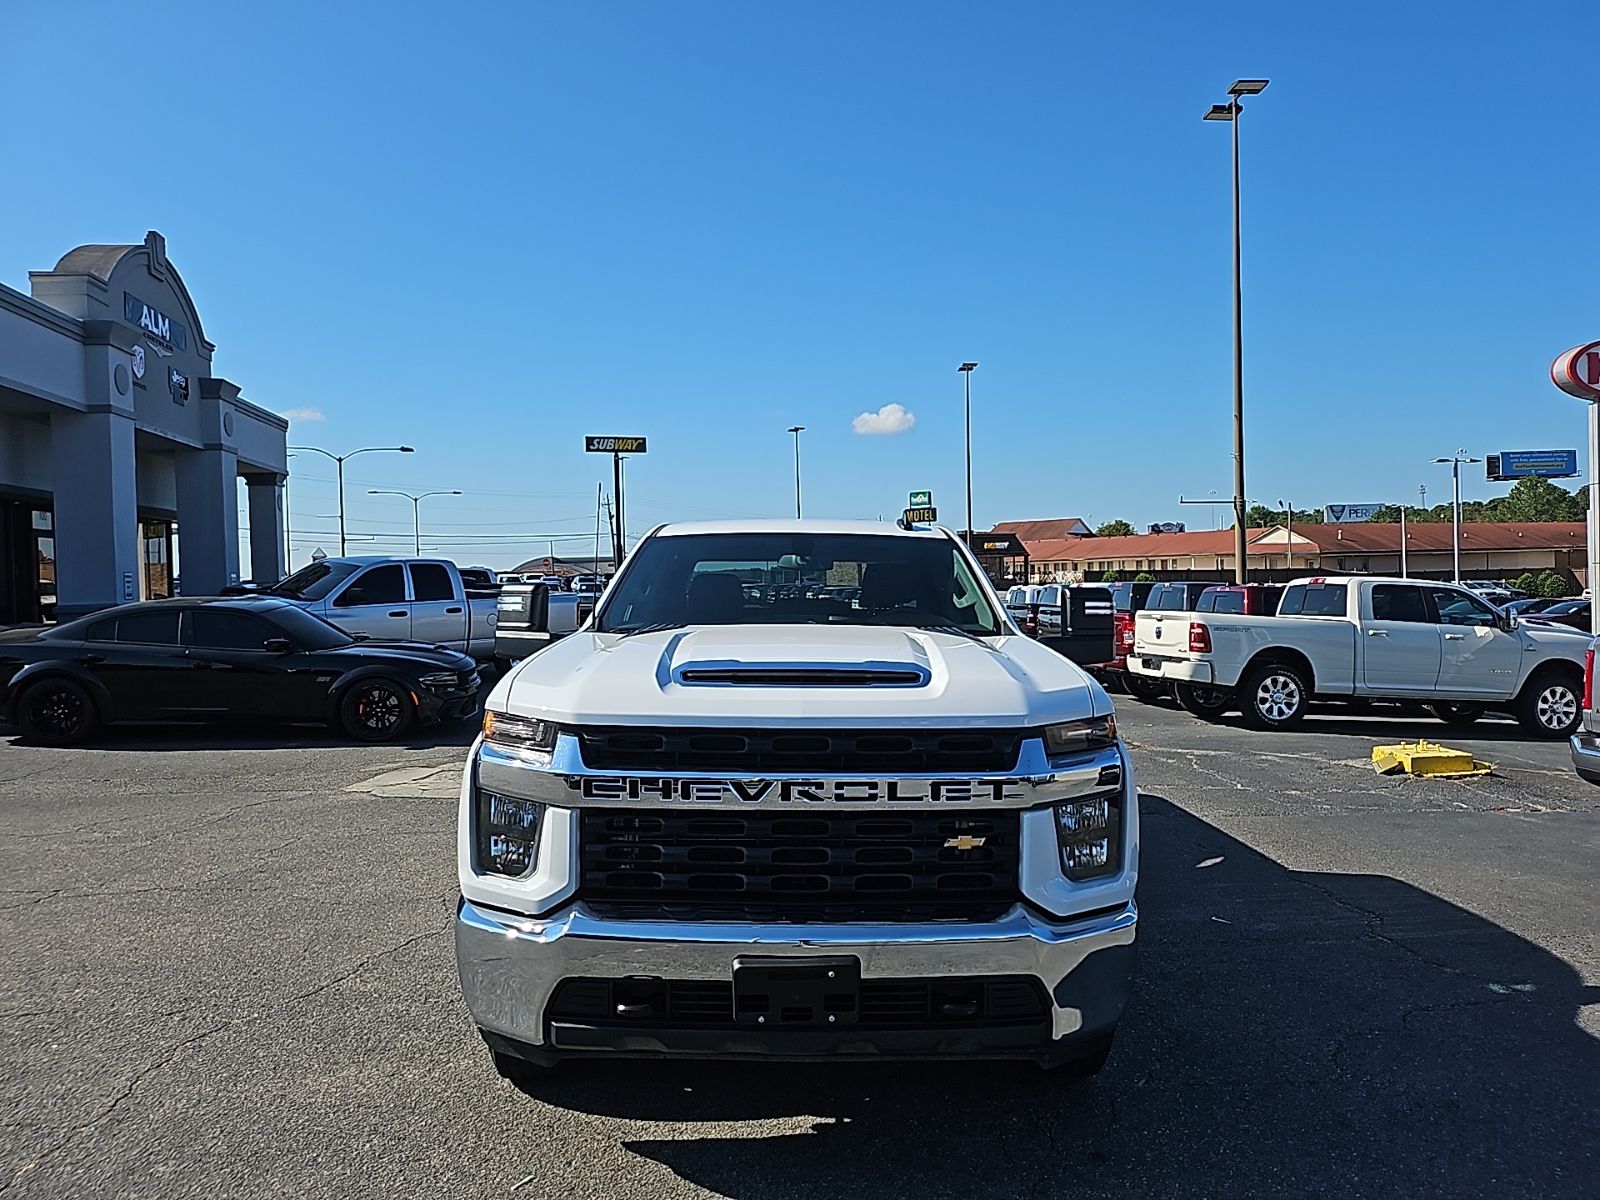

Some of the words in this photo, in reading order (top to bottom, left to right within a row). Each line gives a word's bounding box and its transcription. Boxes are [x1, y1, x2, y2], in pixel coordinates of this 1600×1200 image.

[141, 305, 170, 341] ALM
[171, 369, 186, 388] Jeep
[589, 438, 643, 450] SUBWAY
[906, 509, 934, 522] MOTEL
[581, 777, 1019, 802] CHEVROLET
